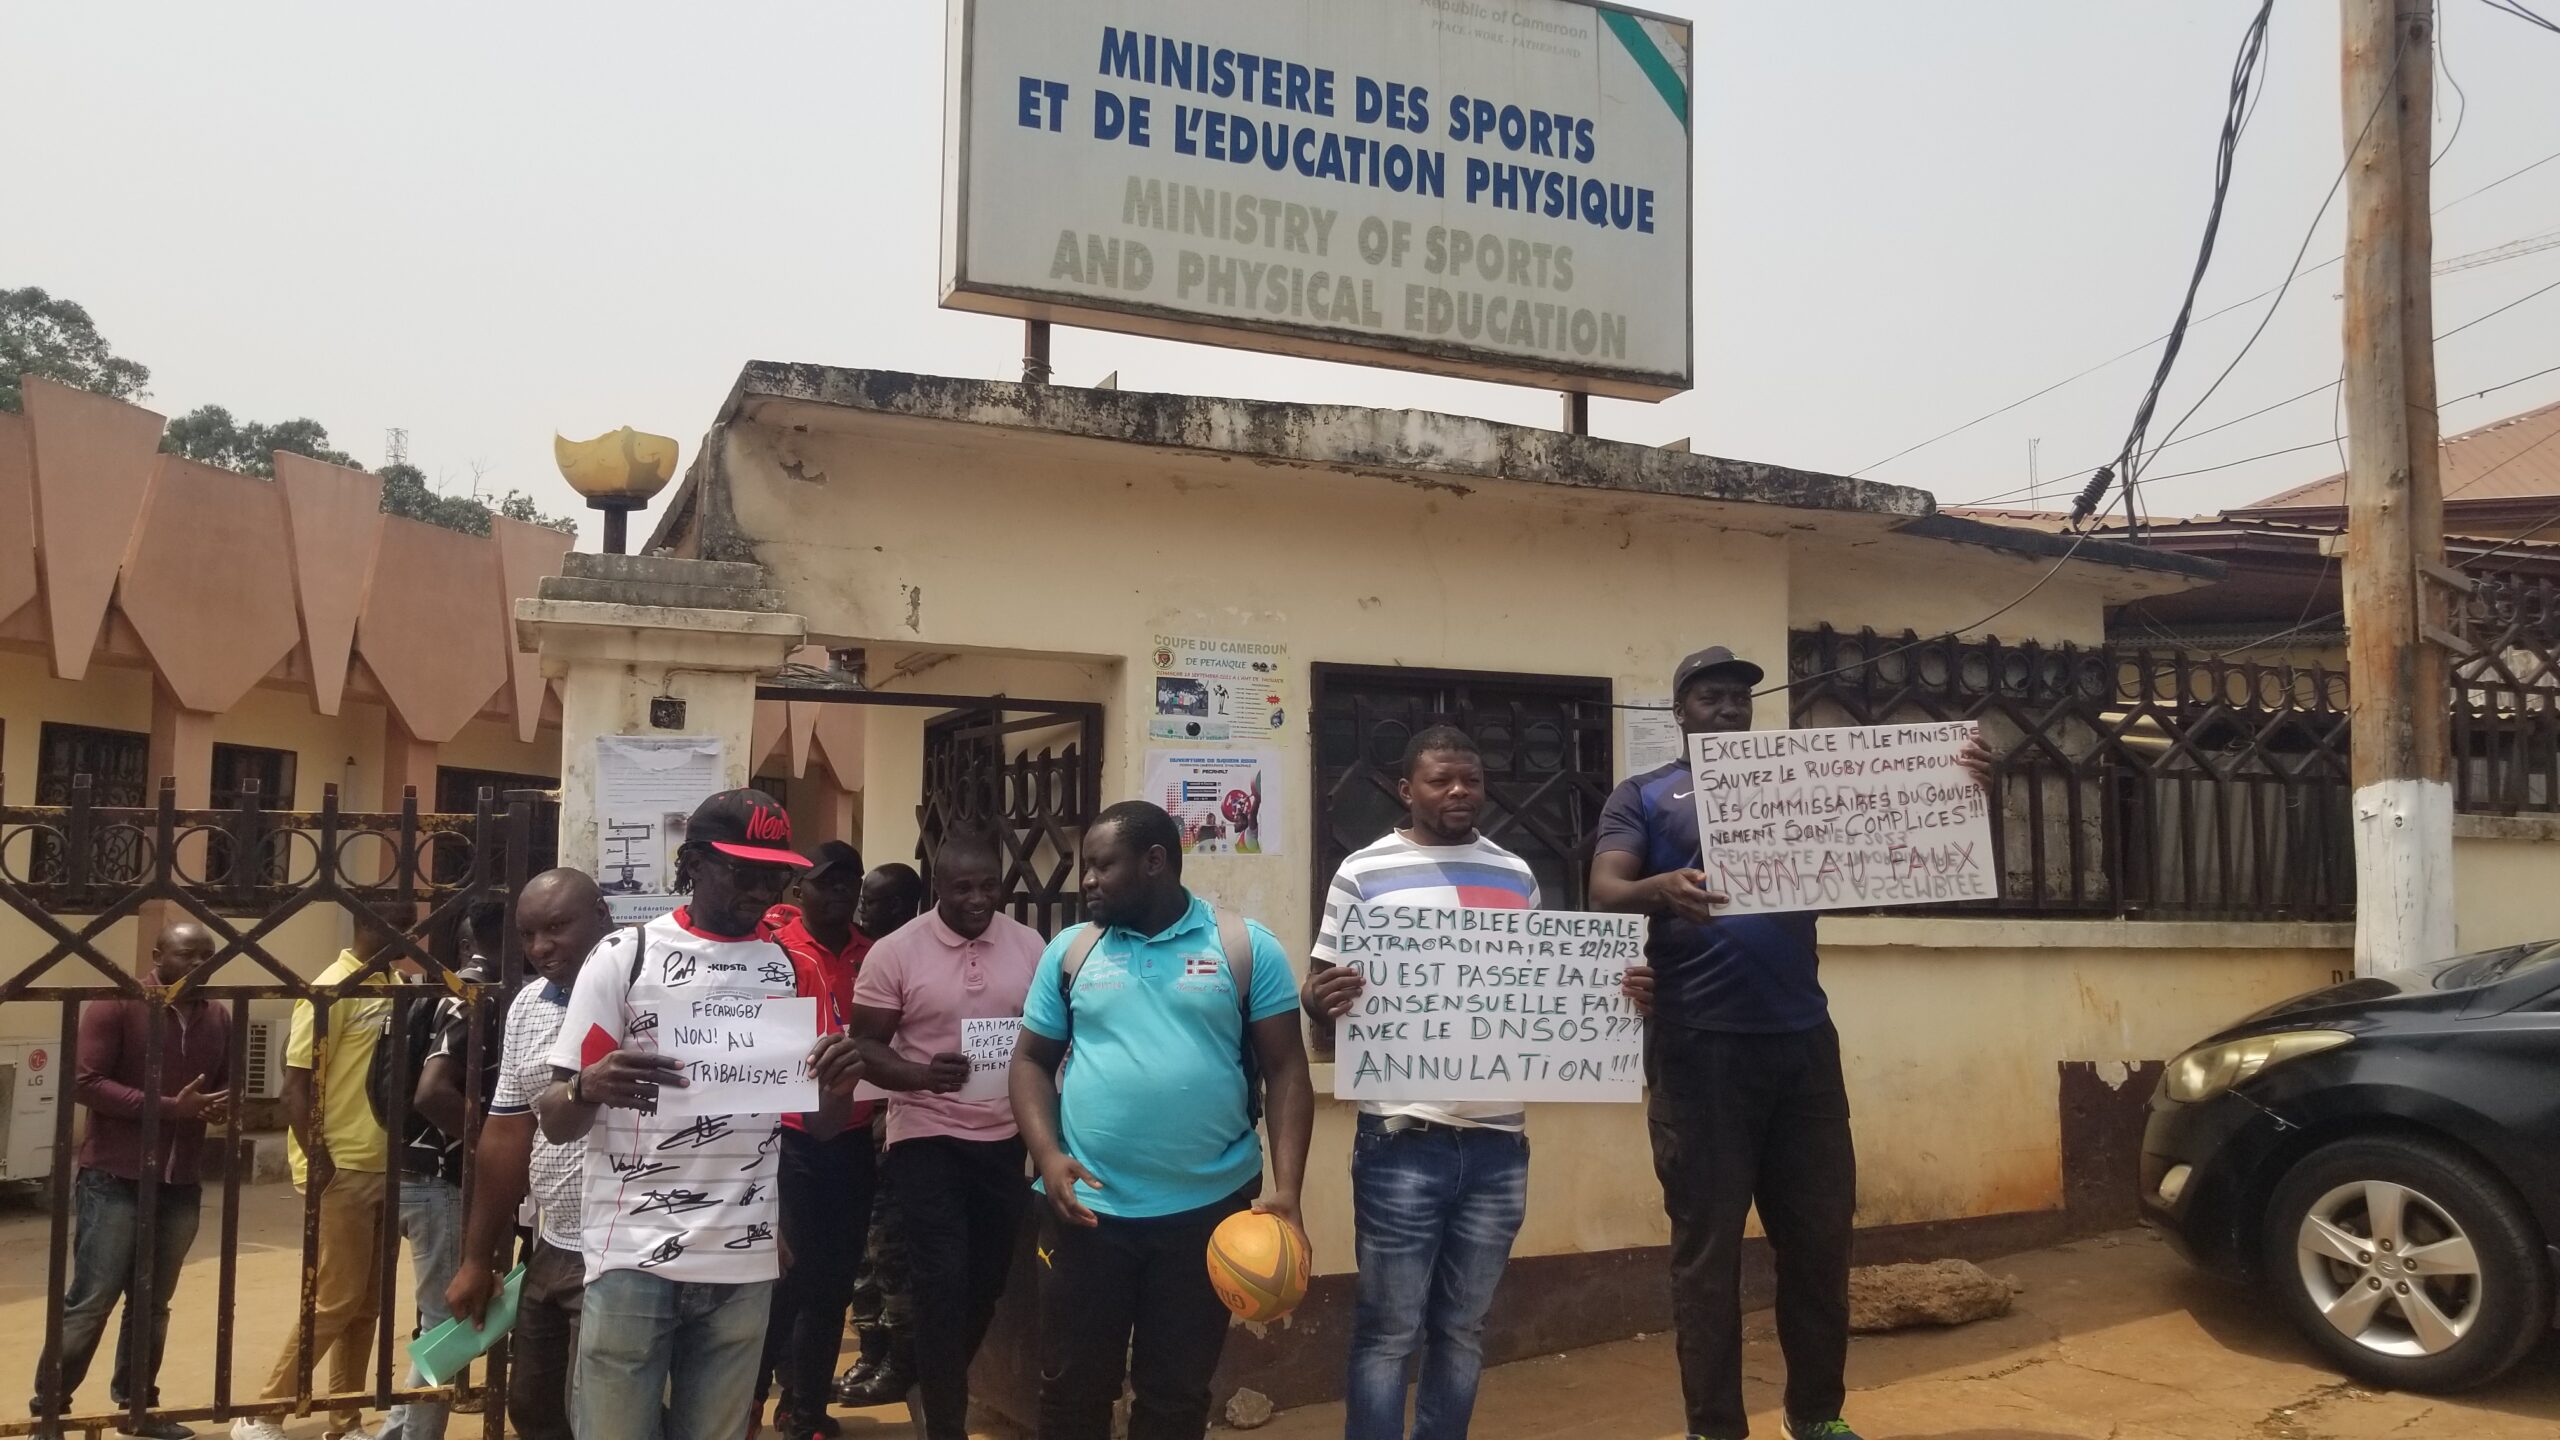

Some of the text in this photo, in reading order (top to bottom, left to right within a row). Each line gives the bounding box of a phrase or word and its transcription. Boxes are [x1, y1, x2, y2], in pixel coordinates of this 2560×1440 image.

[1432, 20, 1464, 36] PEACE
[1475, 28, 1504, 45] WORK
[1512, 37, 1581, 59] FATHERLAND
[1492, 11, 1508, 24] of
[1511, 12, 1588, 40] Cameroon
[1099, 26, 1596, 164] MINISTERE DES SPORTS
[1018, 76, 1655, 235] ET DE L'EDUCATION PHYSIQUE
[1122, 175, 1574, 293] MINISTRY OF SPORTS
[1050, 229, 1627, 361] AND PHYSICAL EDUCATION
[1154, 634, 1288, 655] COUPE DU CAMEROUN
[1185, 657, 1247, 670] DE PETANQUE
[1701, 734, 1838, 763] EXCELLENCE
[1700, 770, 1773, 792] SAUVEZ
[1779, 765, 1797, 784] LE
[1804, 760, 1865, 779] RUGBY
[1706, 800, 1743, 824] LES
[1750, 792, 1891, 820] COMMISSAIRES
[1897, 790, 1920, 806] DU
[1710, 822, 1776, 847] NEMENT
[1782, 816, 1840, 840] SONT
[1720, 840, 1979, 896] NON AU FAUX
[1341, 903, 1641, 939] ASSEMBLEE GENERALE
[1340, 934, 1640, 961] EXTRAORDINAIRE 12/2/23
[1558, 964, 1584, 987] LA
[692, 1001, 763, 1019] FECARUGBY
[674, 1026, 754, 1052] NON! AU
[969, 1034, 1014, 1047] TEXTES
[1348, 1021, 1410, 1042] AVEC
[1423, 1019, 1451, 1041] LE
[28, 1075, 44, 1087] LG
